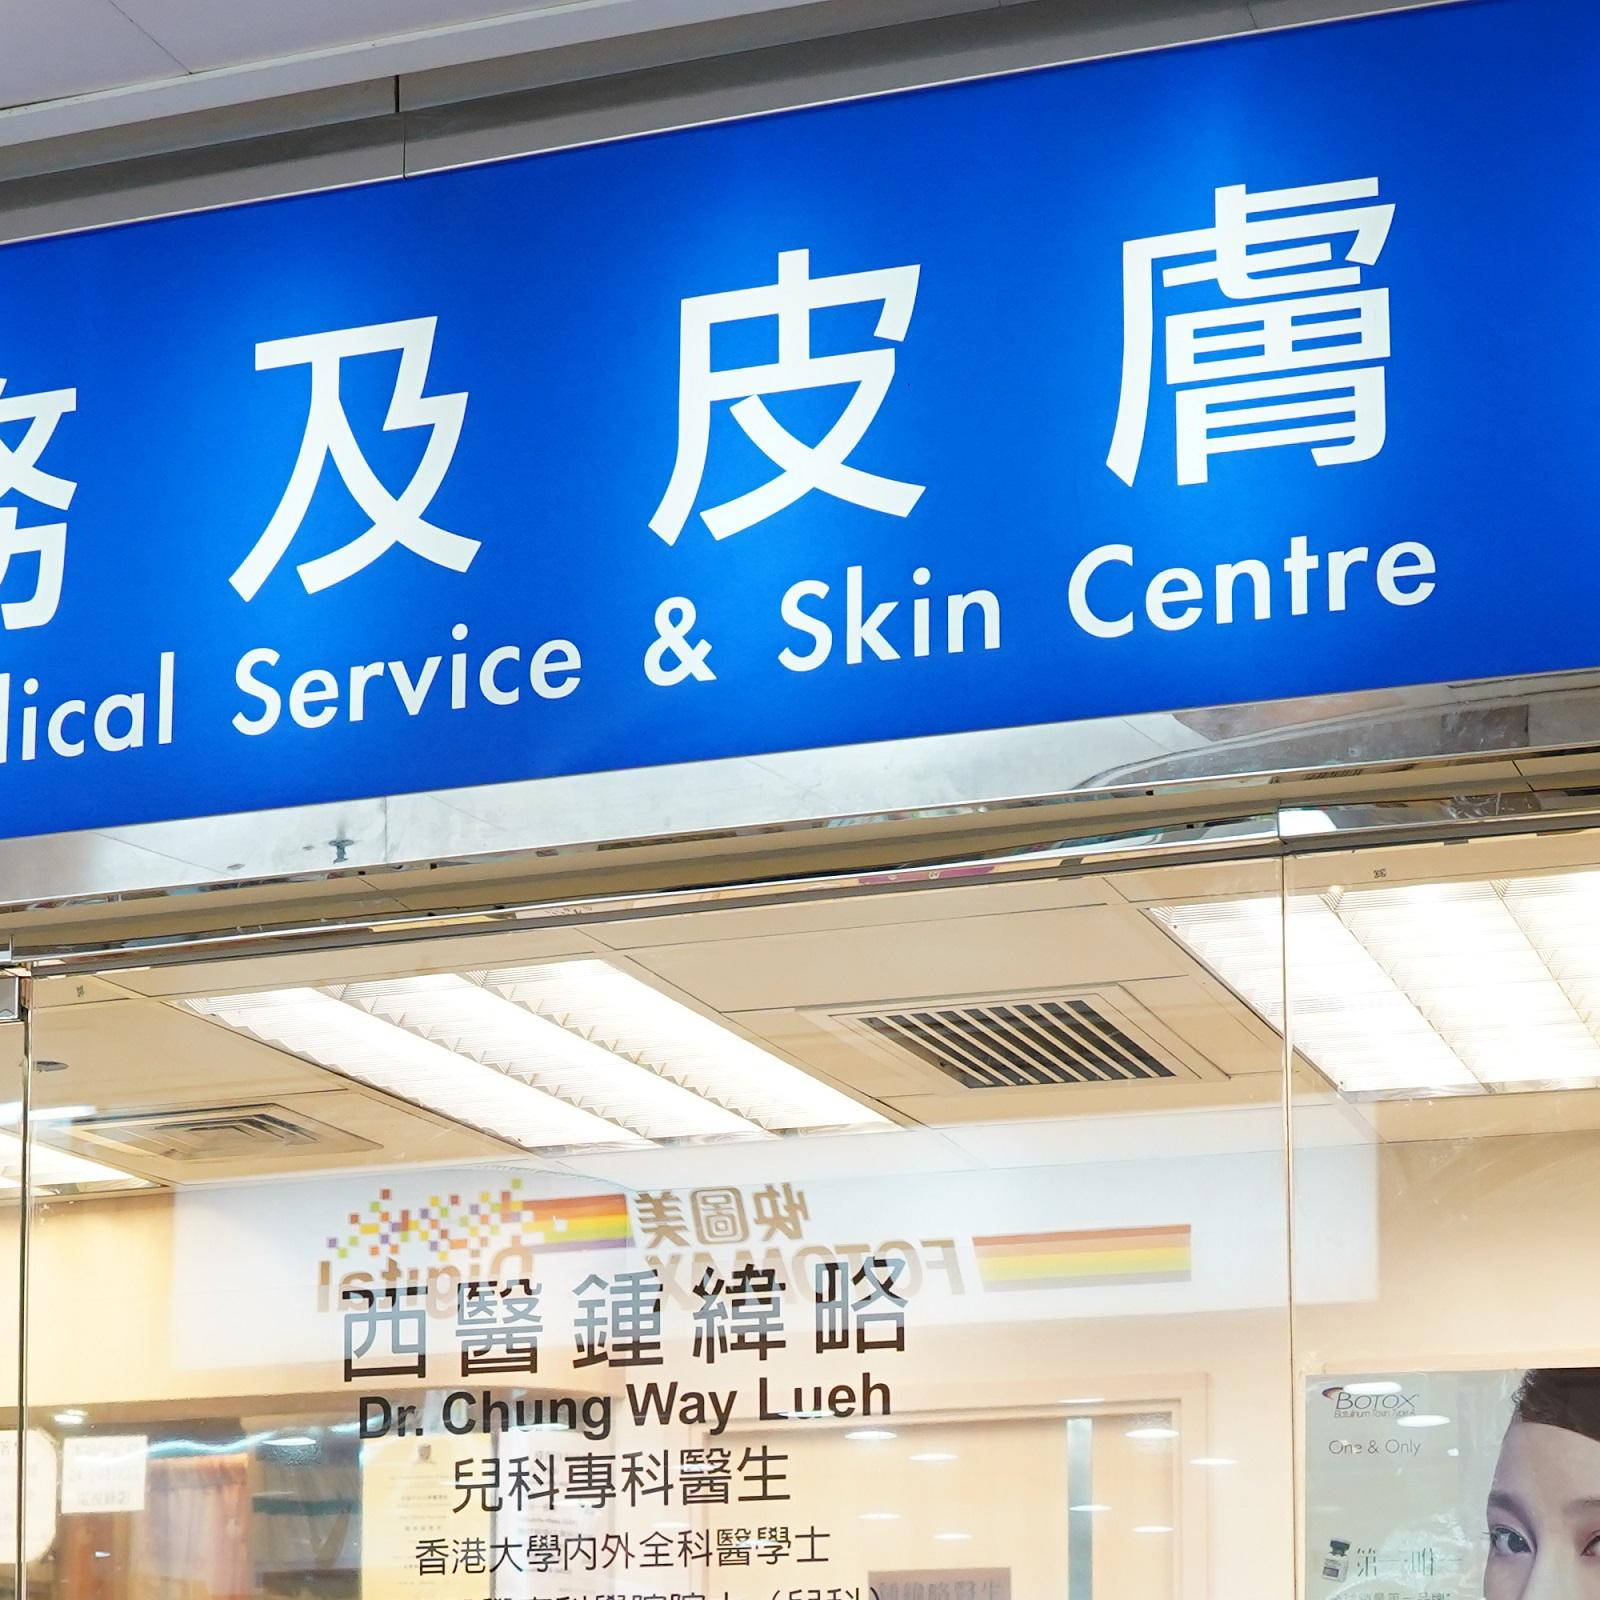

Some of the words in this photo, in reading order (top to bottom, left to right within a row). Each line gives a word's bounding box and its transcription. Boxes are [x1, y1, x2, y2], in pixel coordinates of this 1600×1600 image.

[231, 623, 582, 736] Service
[644, 597, 717, 685] &
[778, 565, 1002, 673] Skin
[1068, 533, 1436, 639] Centre
[342, 1255, 908, 1383] 西醫鍾緯略
[358, 1395, 424, 1440] Dr.
[441, 1385, 612, 1440] Chung
[626, 1381, 738, 1436] Way
[758, 1373, 892, 1421] Lueh
[451, 1445, 791, 1514] 兒科專科醫生
[1329, 1440, 1363, 1454] One
[1367, 1440, 1379, 1454] &
[1385, 1439, 1422, 1456] Only
